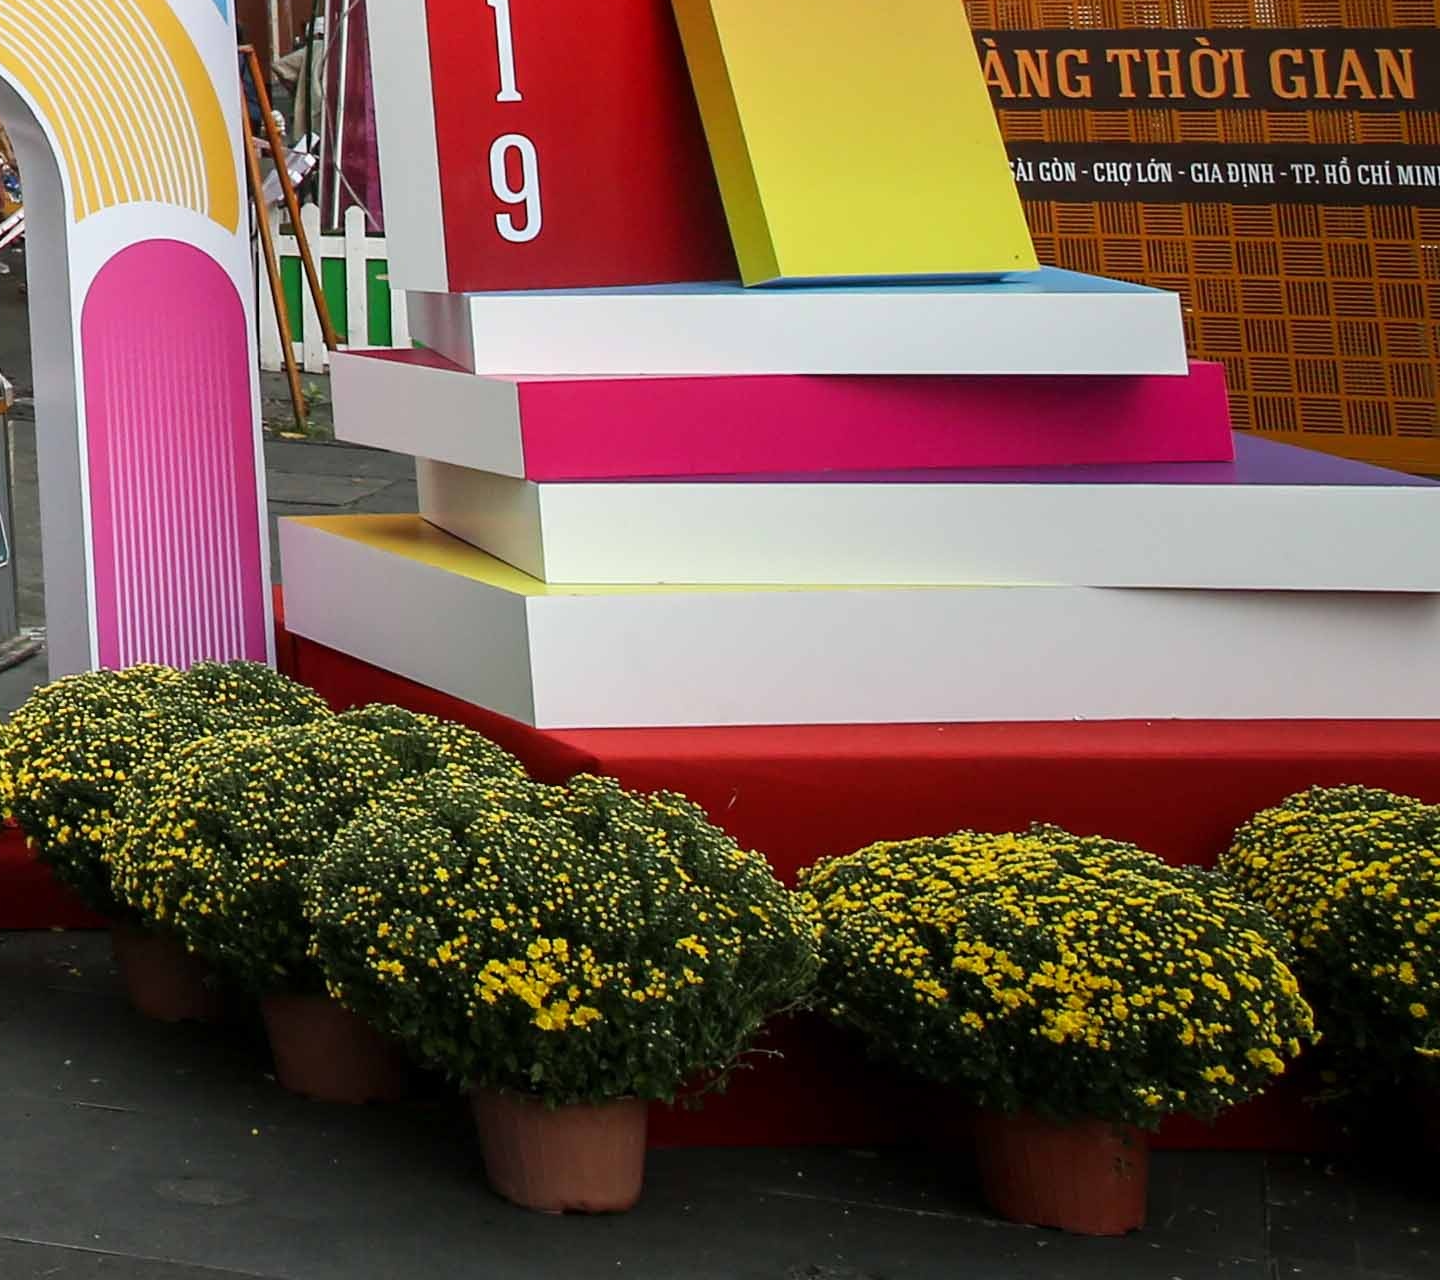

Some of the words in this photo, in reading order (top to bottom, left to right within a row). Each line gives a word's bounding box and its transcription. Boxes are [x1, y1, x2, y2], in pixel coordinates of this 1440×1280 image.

[1106, 37, 1251, 99] THỜI
[1269, 47, 1416, 100] GIAN
[1040, 158, 1076, 182] GÒN
[1093, 162, 1131, 186] CHỢ
[1137, 158, 1173, 182] LỚN
[1190, 163, 1224, 183] GIA
[1227, 163, 1275, 188] ĐỊNH
[1290, 164, 1320, 184] TP.
[1324, 156, 1351, 184] HỒ
[1357, 160, 1392, 185] CHÍ
[1396, 164, 1440, 186] MIN
